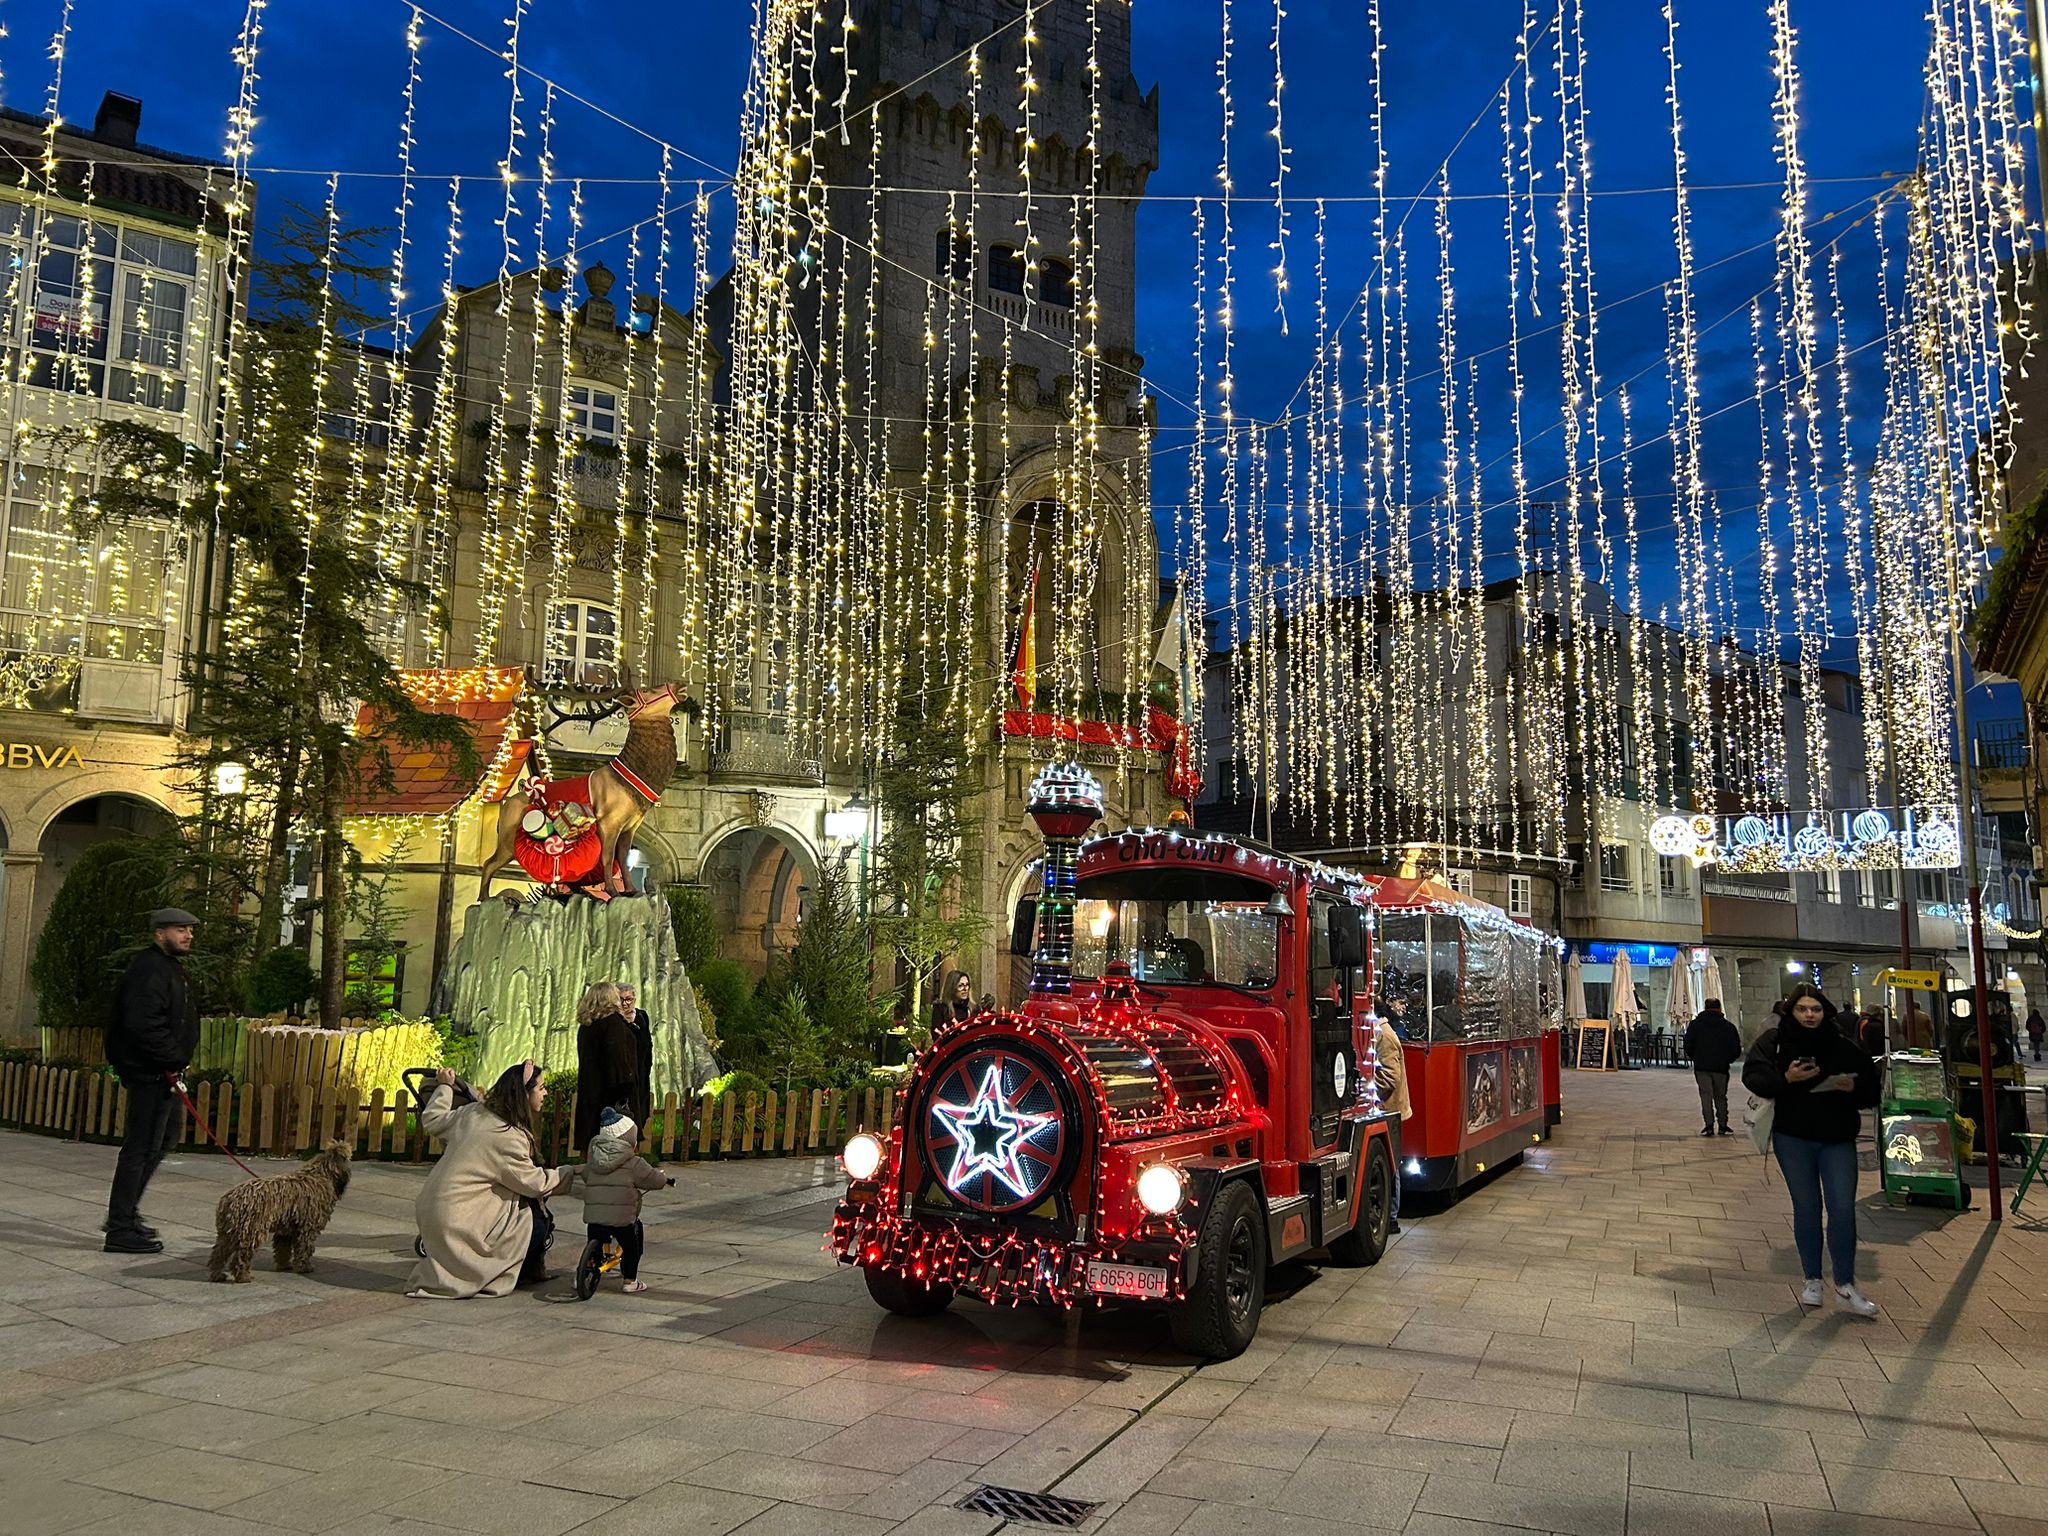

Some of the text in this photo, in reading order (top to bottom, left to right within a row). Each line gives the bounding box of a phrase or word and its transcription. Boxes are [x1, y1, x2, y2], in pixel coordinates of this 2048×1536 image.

[0, 743, 86, 769] BVA
[1896, 977, 1919, 985] ONCE
[1089, 1267, 1166, 1291] E 6653 BGH
